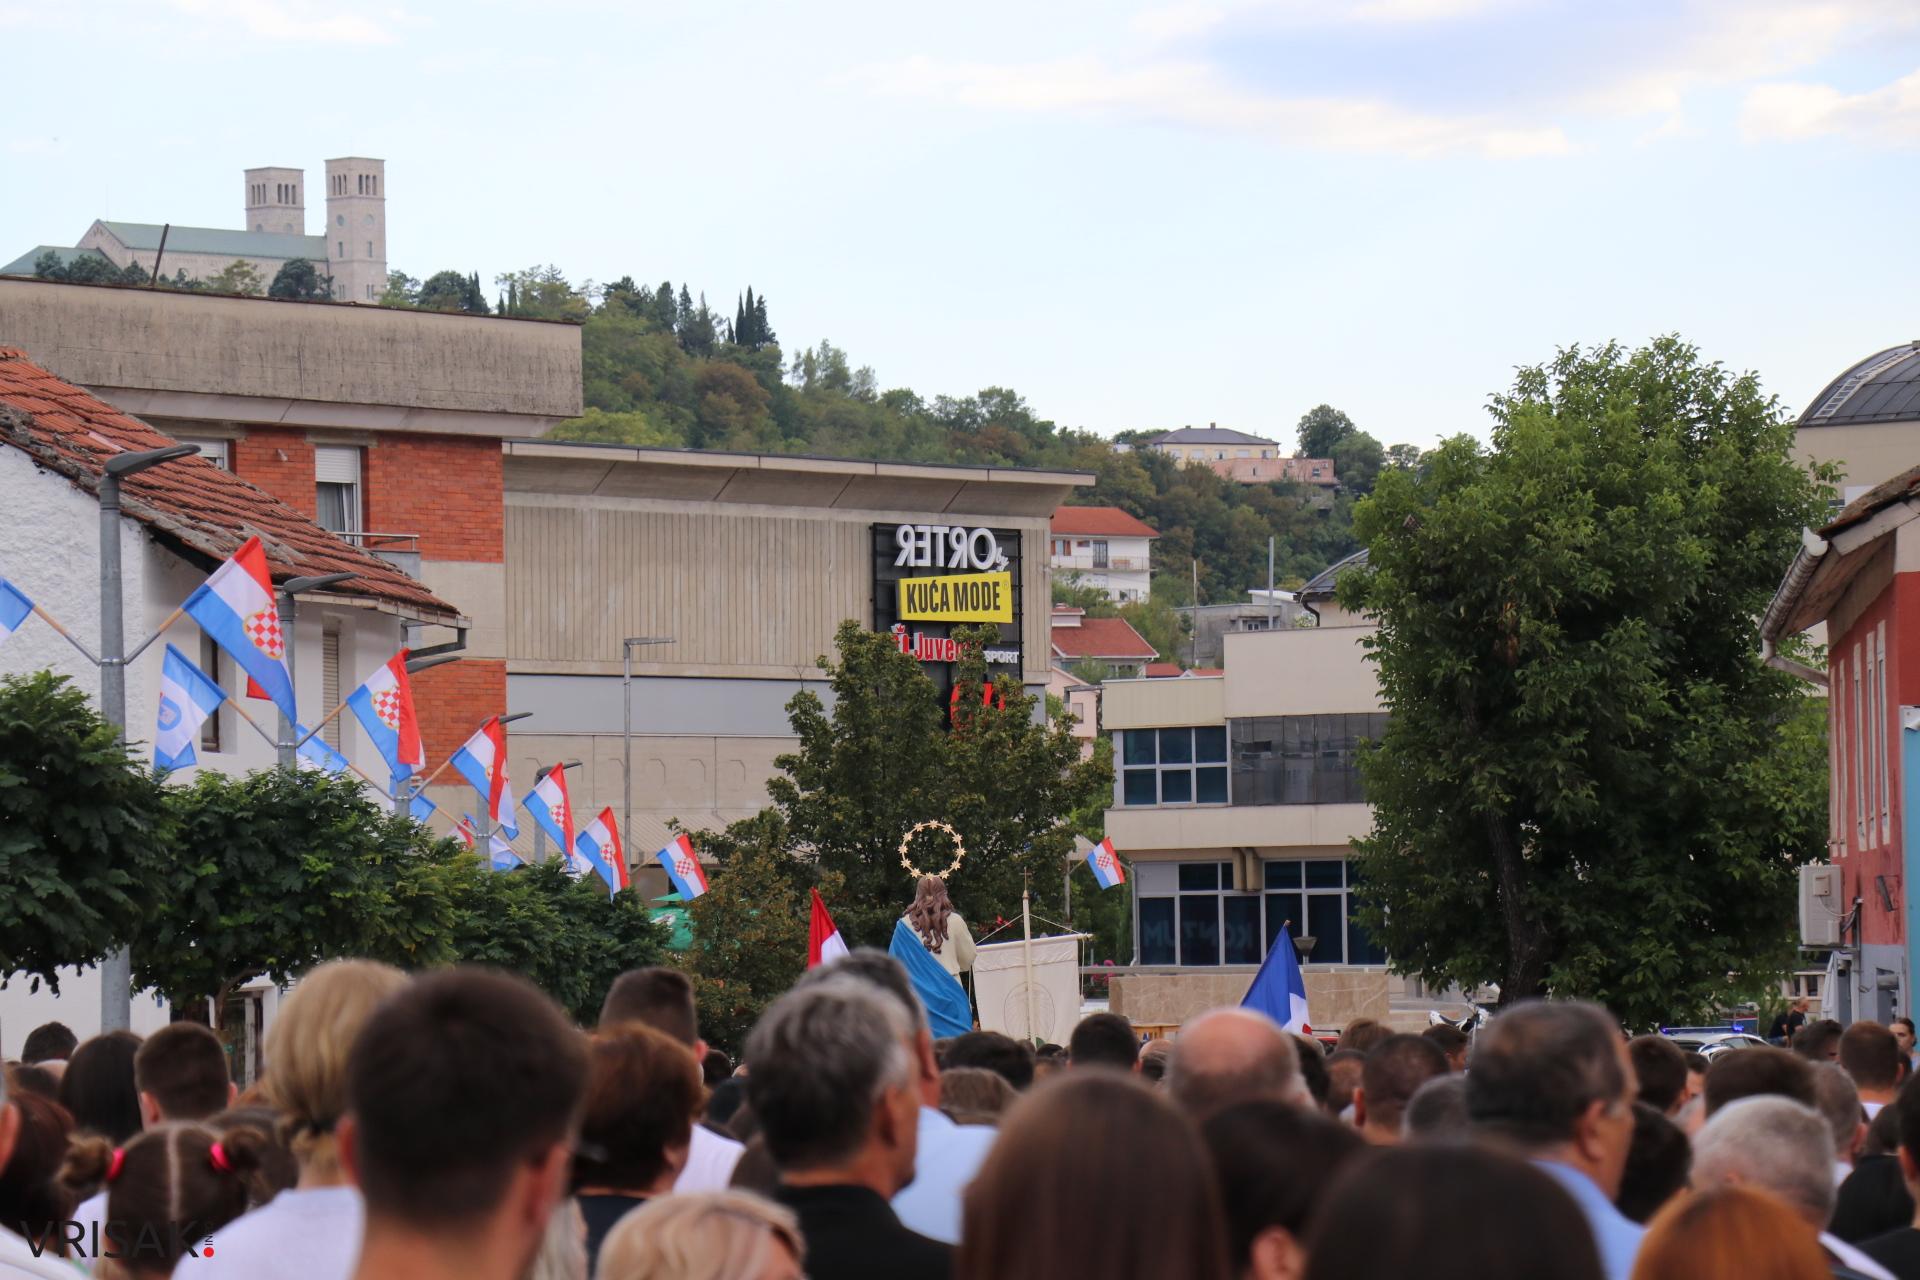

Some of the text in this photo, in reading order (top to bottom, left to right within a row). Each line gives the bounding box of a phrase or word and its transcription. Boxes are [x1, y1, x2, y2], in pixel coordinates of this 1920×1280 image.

[906, 580, 1001, 614] KUĆA MODE
[984, 650, 1020, 664] SPORT
